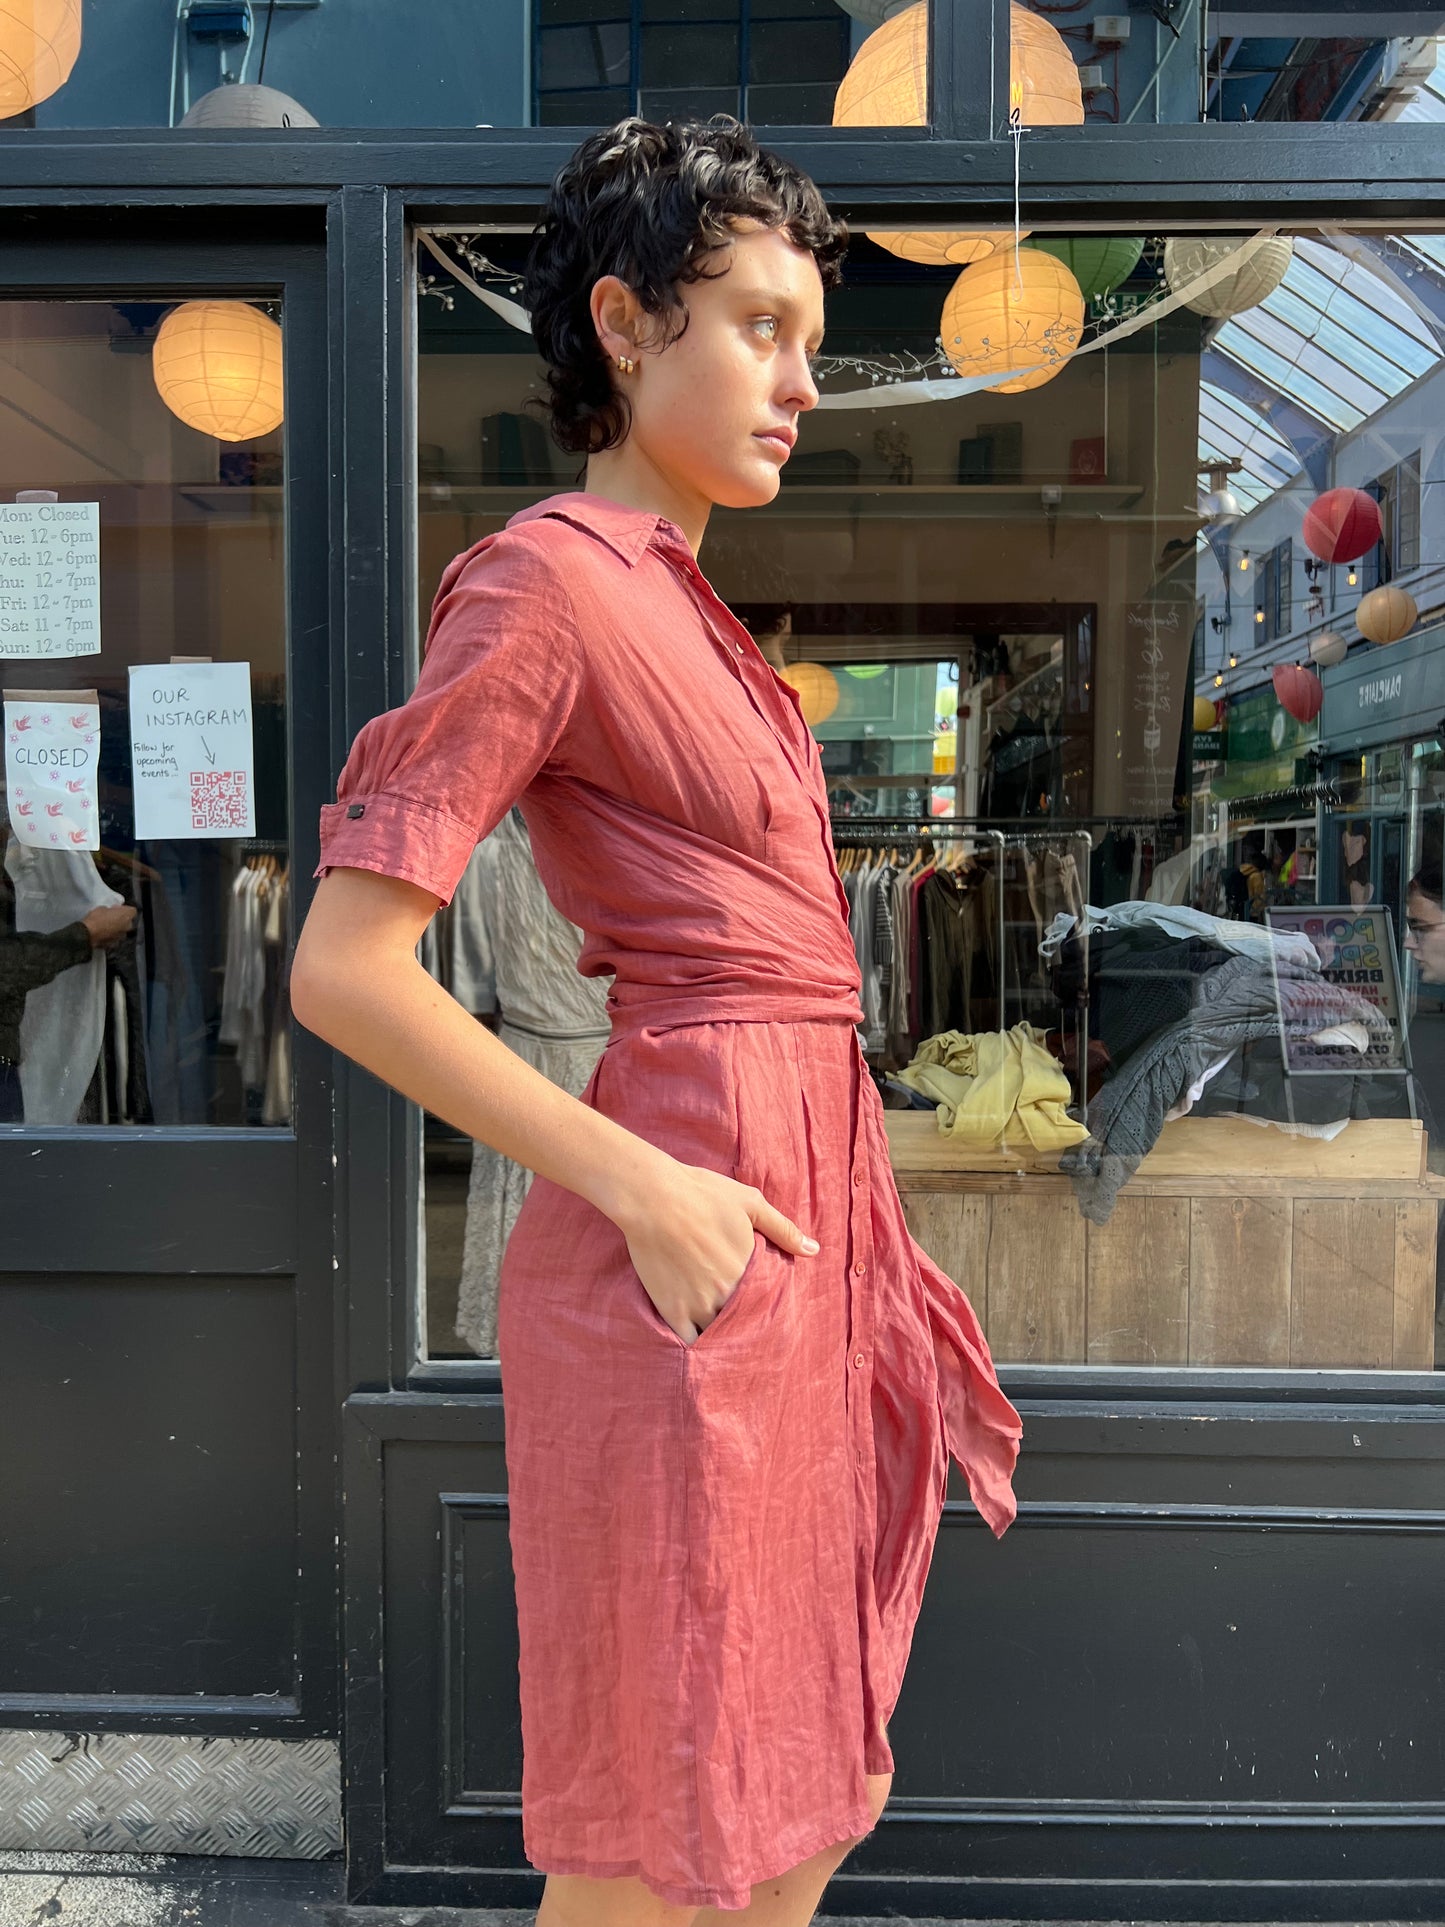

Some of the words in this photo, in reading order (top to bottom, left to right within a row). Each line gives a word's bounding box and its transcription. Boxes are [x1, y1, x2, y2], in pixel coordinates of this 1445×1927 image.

[38, 506, 90, 521] Closed
[31, 528, 48, 543] 12
[61, 528, 94, 547] 6pm
[36, 551, 53, 566] 12
[66, 551, 98, 569] 6pm
[36, 572, 53, 588] 12
[66, 572, 96, 591] 7pm
[0, 596, 27, 610] Fri:
[33, 594, 50, 610] 12
[63, 595, 94, 613] 7pm
[0, 618, 29, 632] Sat:
[34, 618, 49, 632] 11
[65, 617, 93, 634] 7pm
[36, 638, 53, 653] 12
[66, 638, 96, 656] 6pm
[152, 688, 190, 704] OUR
[146, 708, 248, 727] INSTAGRAM
[15, 747, 89, 768] CLOSED
[133, 742, 158, 753] Follow
[160, 741, 175, 758] for
[136, 757, 179, 771] upcoming
